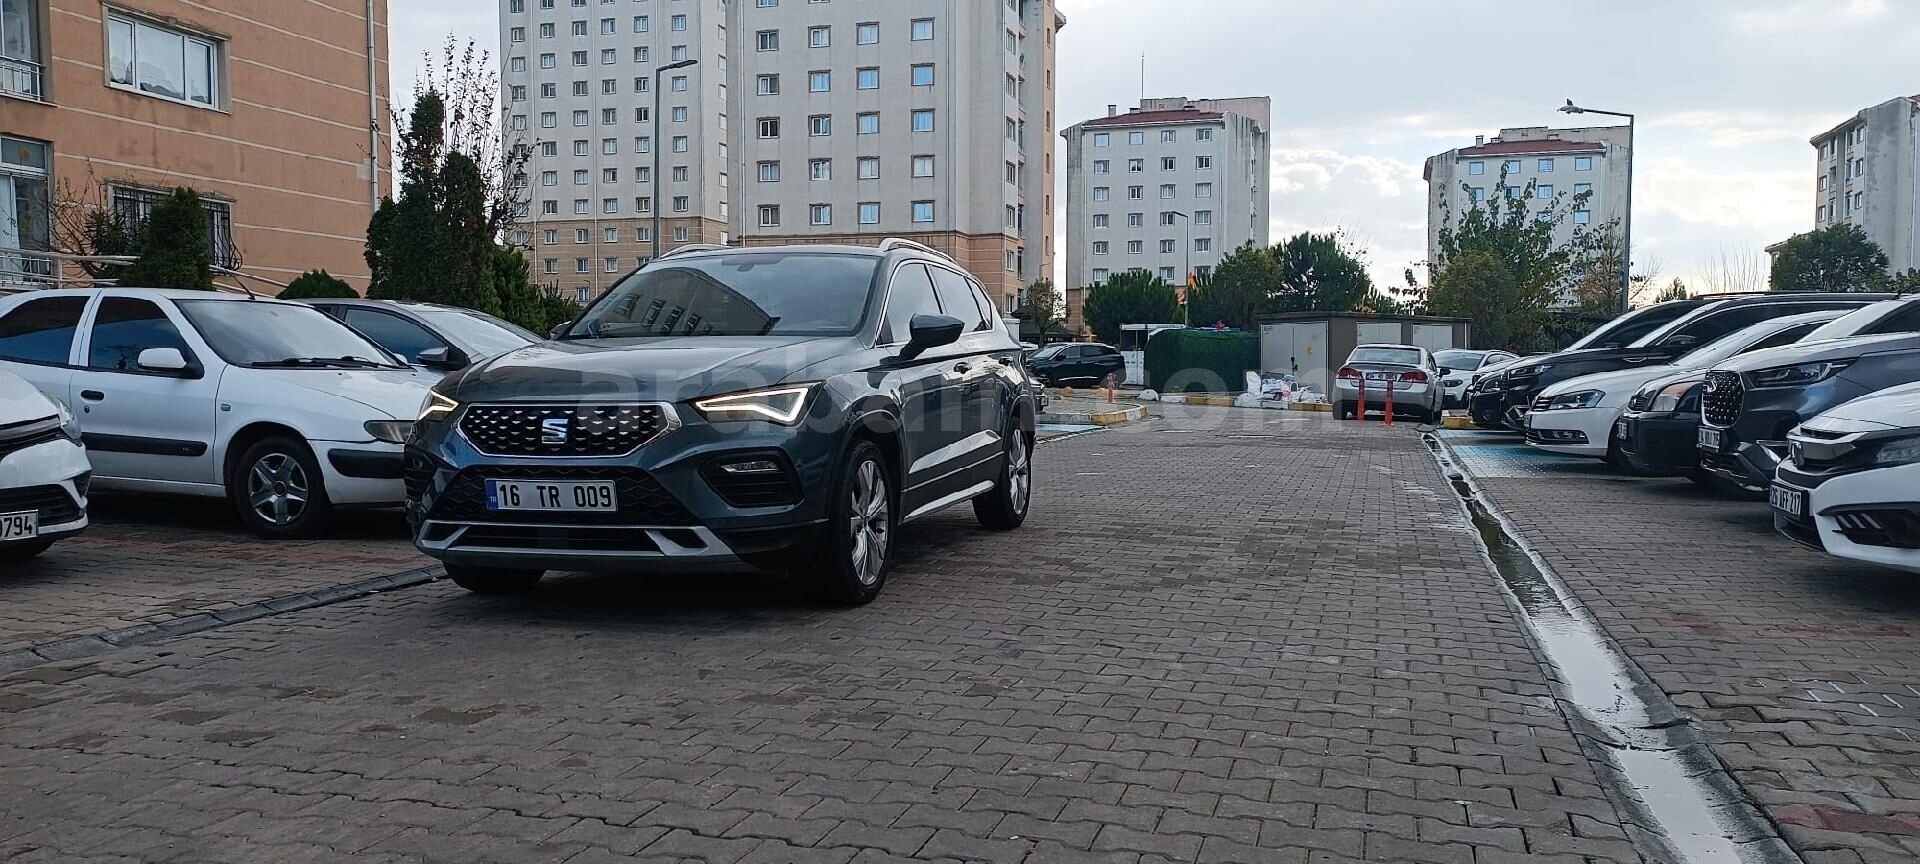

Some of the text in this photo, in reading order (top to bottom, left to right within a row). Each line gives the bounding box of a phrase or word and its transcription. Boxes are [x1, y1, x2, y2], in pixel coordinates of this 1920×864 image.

[499, 484, 612, 508] 16 TR 009
[1790, 492, 1801, 515] 217
